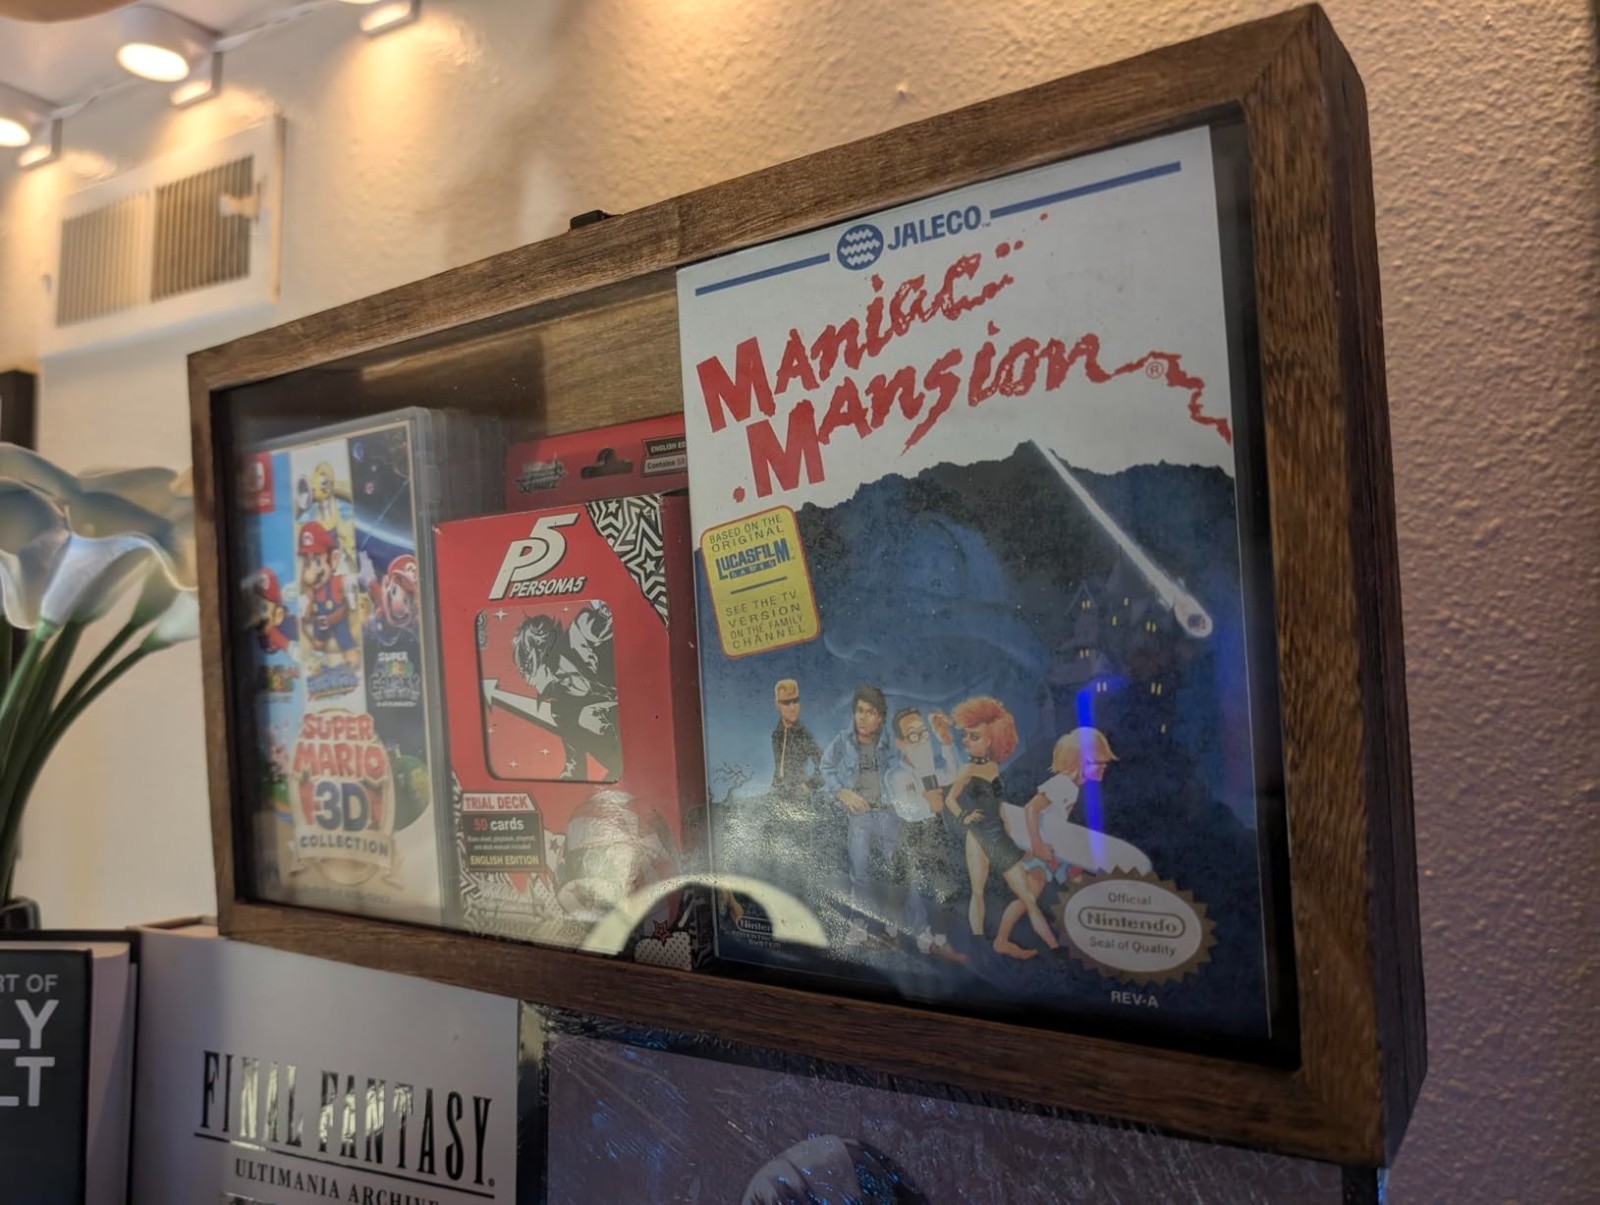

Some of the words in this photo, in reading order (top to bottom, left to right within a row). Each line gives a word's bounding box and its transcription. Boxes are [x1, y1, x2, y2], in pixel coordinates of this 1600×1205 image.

[887, 205, 982, 250] JALECO
[709, 527, 741, 544] BASED
[744, 521, 758, 533] ON
[762, 514, 782, 527] THE
[711, 525, 784, 553] ORIGINAL
[715, 538, 790, 581] LUCASFILM
[509, 576, 587, 598] PERSONA5
[725, 603, 748, 617] SEE
[753, 595, 777, 609] THE
[782, 590, 798, 600] TV
[728, 603, 801, 628] VERSION
[730, 629, 744, 640] ON
[747, 624, 766, 637] THE
[769, 614, 804, 632] FAMILY
[733, 626, 805, 649] CHANNEL
[303, 713, 374, 742] SUPER
[293, 742, 387, 780] MARIO
[315, 780, 370, 832] 3D
[464, 796, 495, 810] TRIAL
[497, 795, 529, 810] DECK
[490, 817, 524, 831] cards
[301, 835, 389, 857] COLLECTION
[470, 855, 503, 865] ENGLISH
[505, 855, 539, 865] EDITION
[1108, 892, 1151, 906] Official
[1087, 912, 1178, 934] Nintendo
[1089, 936, 1114, 949] Seal
[1118, 941, 1129, 950] of
[1132, 941, 1178, 958] Quality
[26, 974, 58, 992] OF
[1110, 990, 1159, 1009] REV-A
[200, 1050, 303, 1147] FINAL
[236, 1158, 339, 1198] ULTIMANIA
